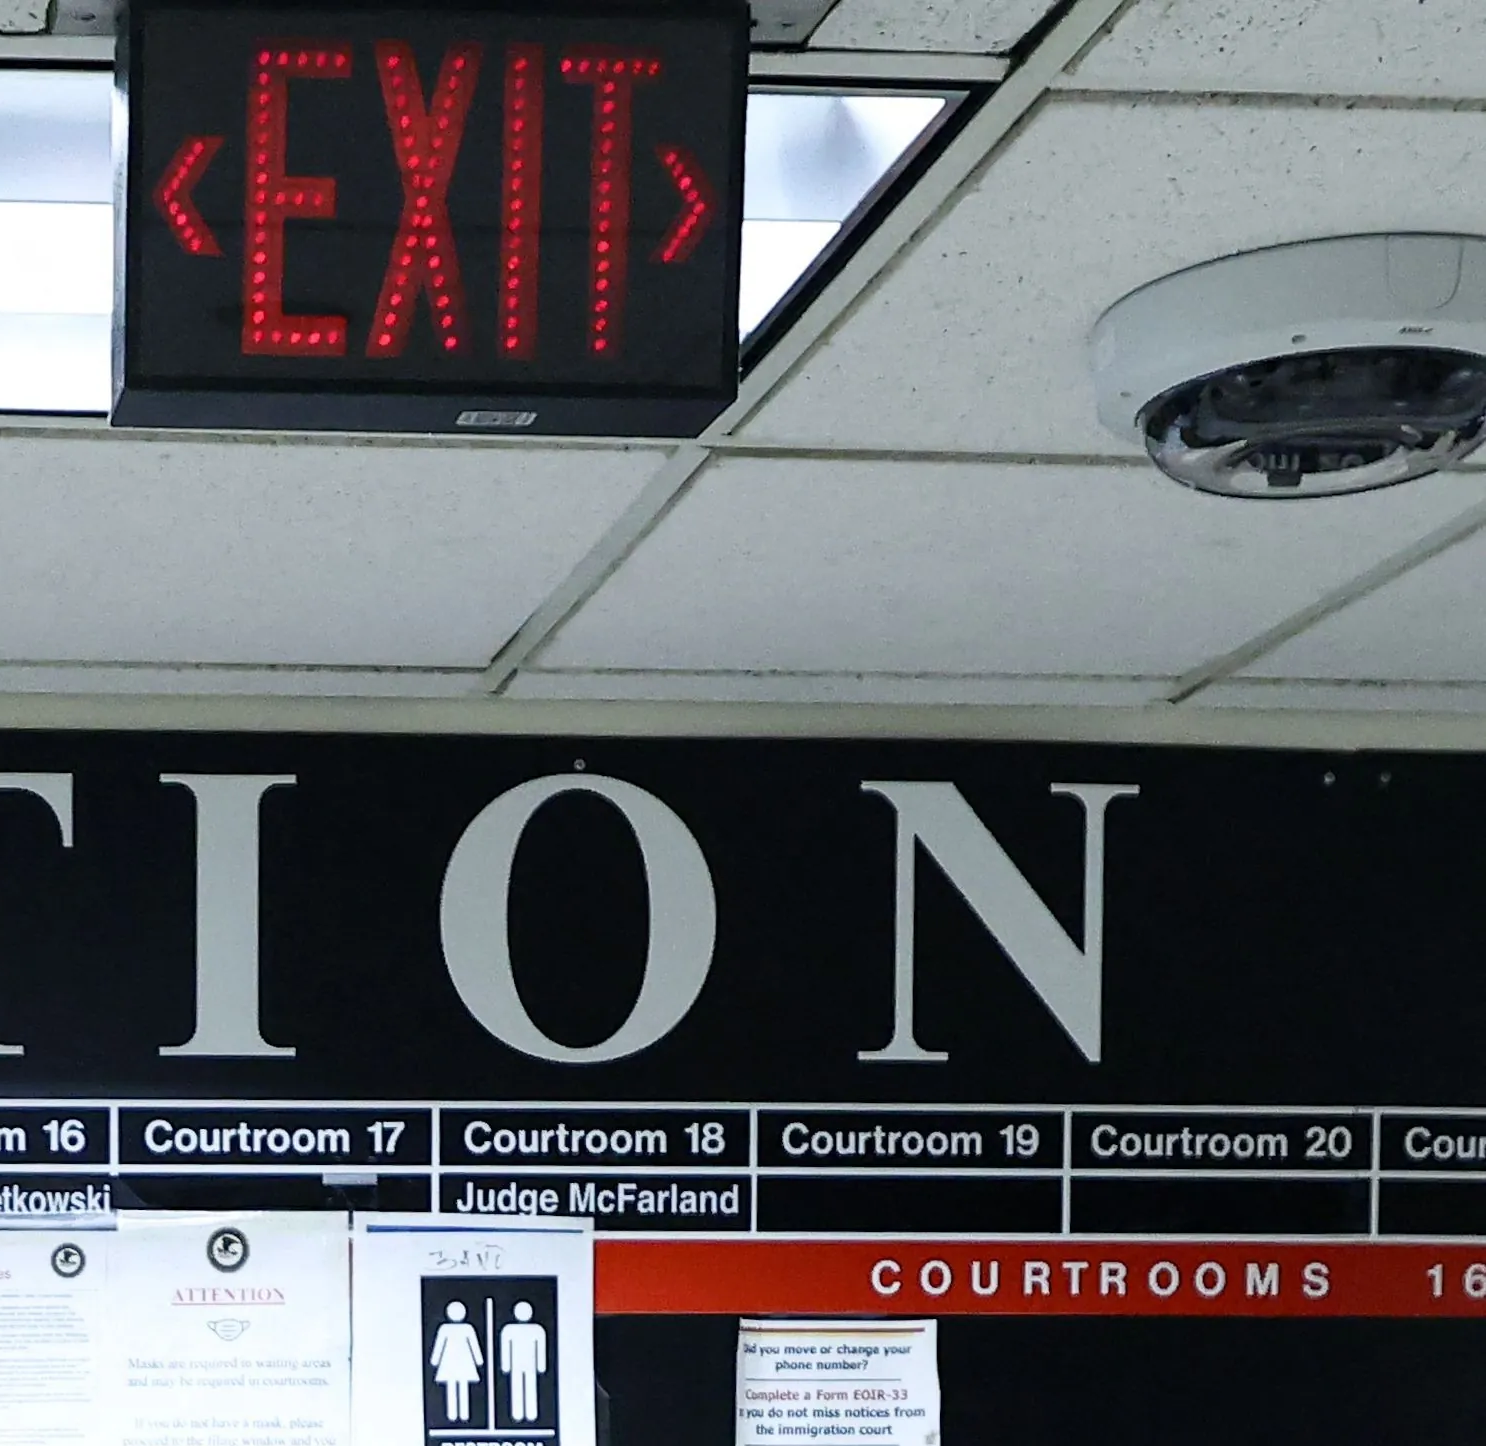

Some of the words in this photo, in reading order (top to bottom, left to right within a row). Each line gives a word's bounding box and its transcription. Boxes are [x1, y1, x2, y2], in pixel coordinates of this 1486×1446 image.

[241, 38, 662, 358] EXIT
[43, 1120, 85, 1152] 16
[145, 1120, 350, 1153] Courtroom
[367, 1122, 405, 1152] 17
[465, 1121, 667, 1153] Courtroom
[685, 1123, 725, 1154] 18
[782, 1123, 982, 1155] Courtroom
[1000, 1124, 1039, 1155] 19
[1092, 1125, 1287, 1157] Courtroom
[1306, 1126, 1351, 1157] 20
[456, 1181, 559, 1214] Judge
[570, 1183, 738, 1214] McFarland
[871, 1260, 1328, 1296] COURTROOMS
[171, 1287, 285, 1302] ATTENTION
[776, 1361, 812, 1372] phone
[837, 1344, 879, 1357] change
[744, 1389, 799, 1402] Complete
[817, 1390, 848, 1401] Form
[768, 1408, 783, 1418] do
[788, 1408, 808, 1417] not
[813, 1408, 840, 1418] miss
[845, 1408, 890, 1417] notices
[894, 1407, 925, 1417] from
[756, 1424, 774, 1435] the
[779, 1424, 855, 1437] immigration
[859, 1426, 892, 1435] court
